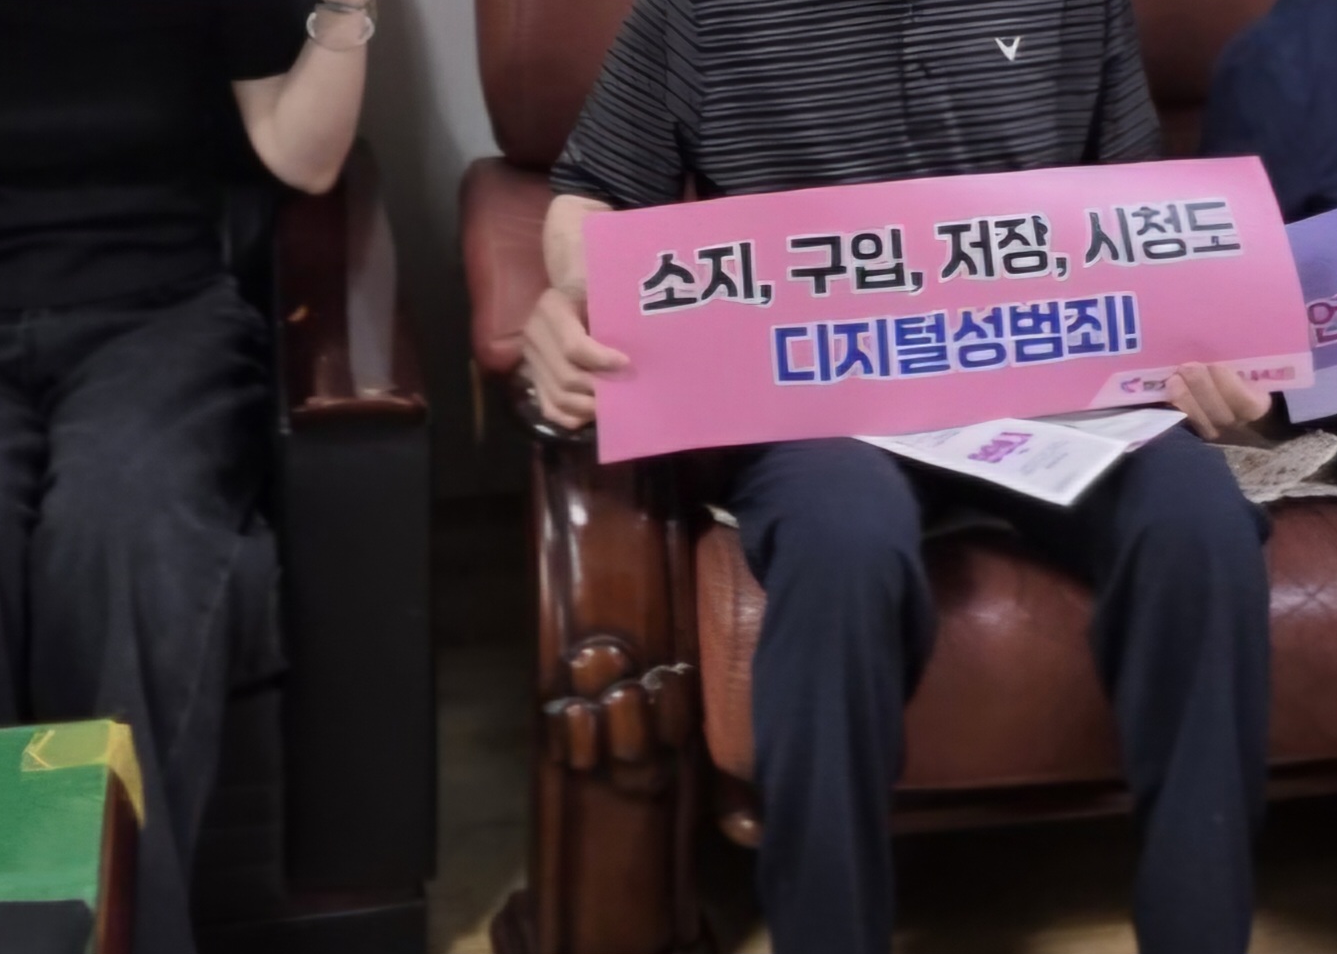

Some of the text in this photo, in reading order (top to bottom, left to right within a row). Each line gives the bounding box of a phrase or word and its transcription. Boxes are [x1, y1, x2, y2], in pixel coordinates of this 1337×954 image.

[643, 201, 1241, 311] 소지, 구입, 저장, 시청도
[774, 295, 1138, 382] 디지털성범죄!
